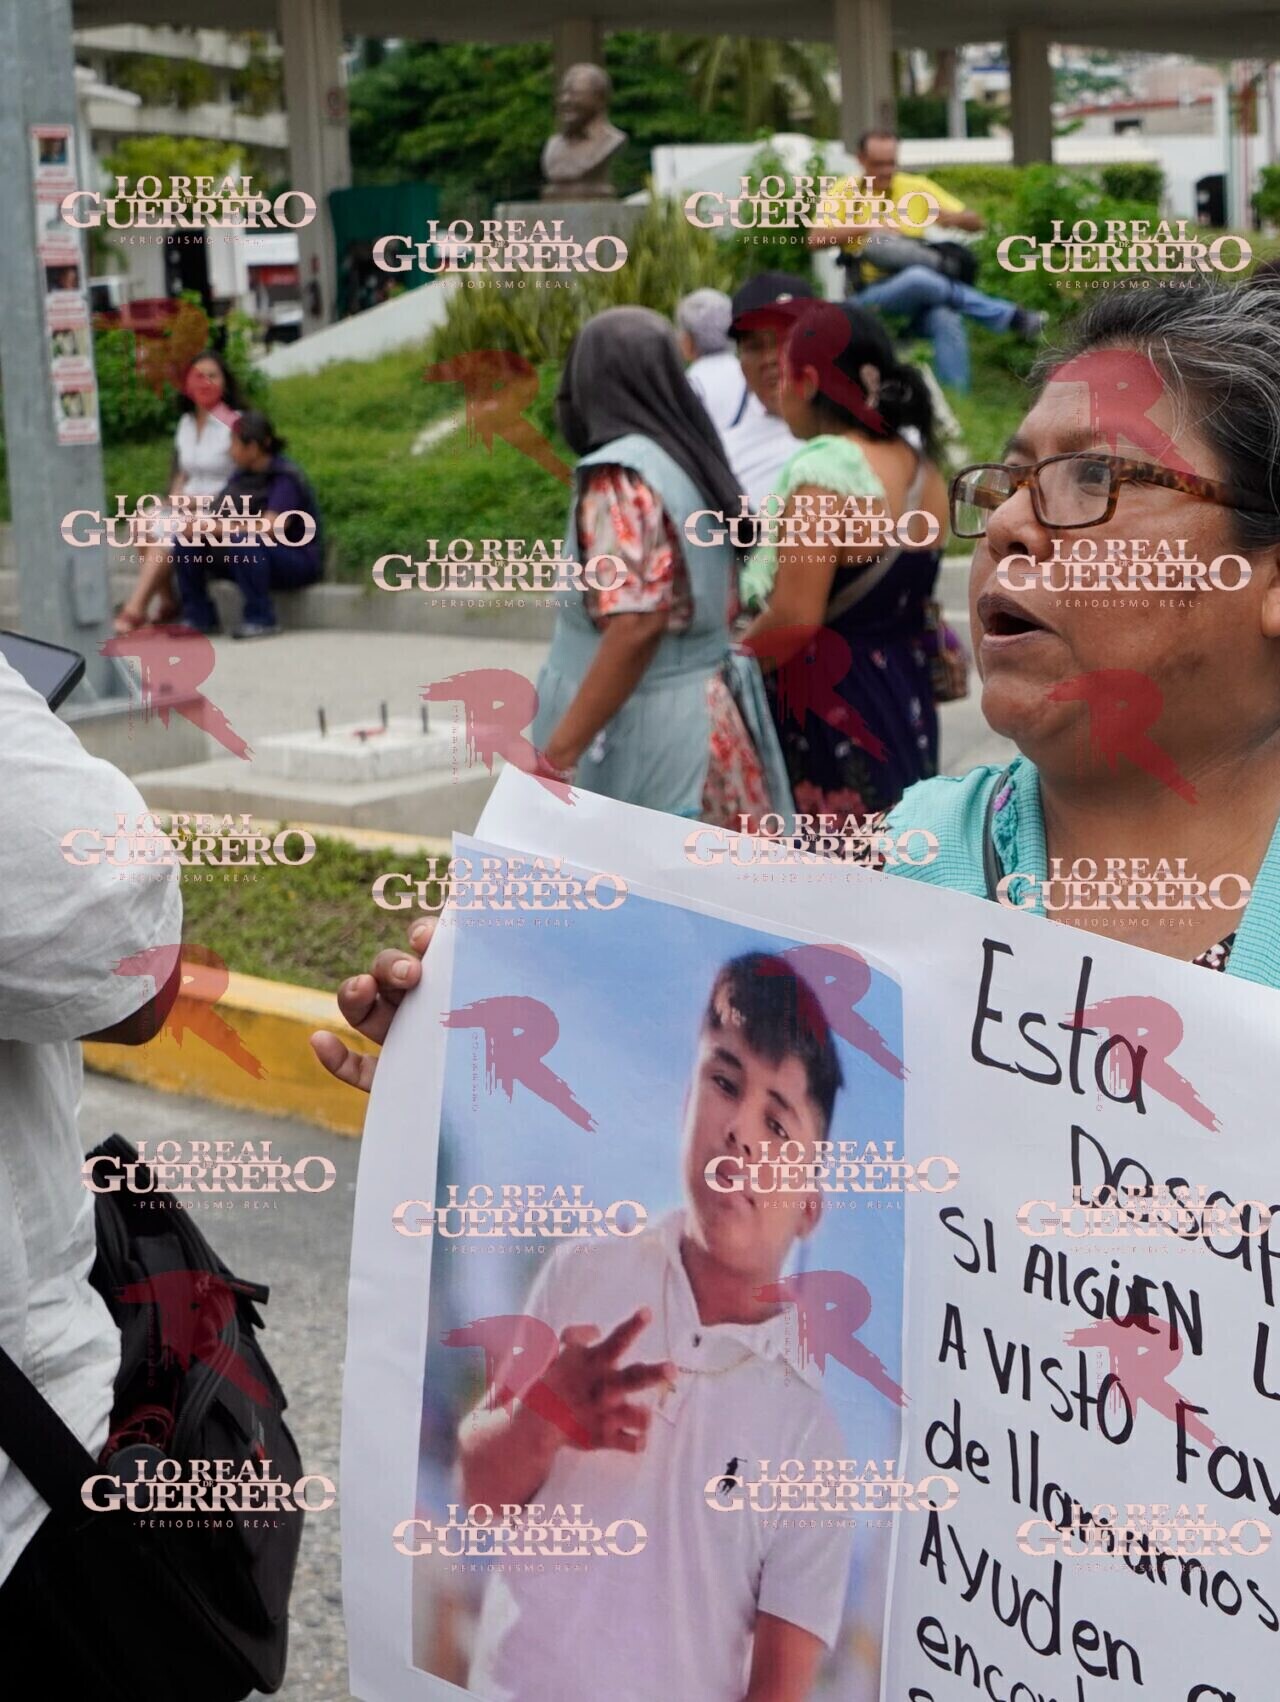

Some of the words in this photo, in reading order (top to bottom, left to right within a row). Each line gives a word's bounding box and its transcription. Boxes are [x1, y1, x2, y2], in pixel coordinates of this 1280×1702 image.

[971, 938, 1148, 1115] Esta
[939, 1206, 997, 1273] SI
[938, 1303, 967, 1370] A
[925, 1398, 990, 1484] de
